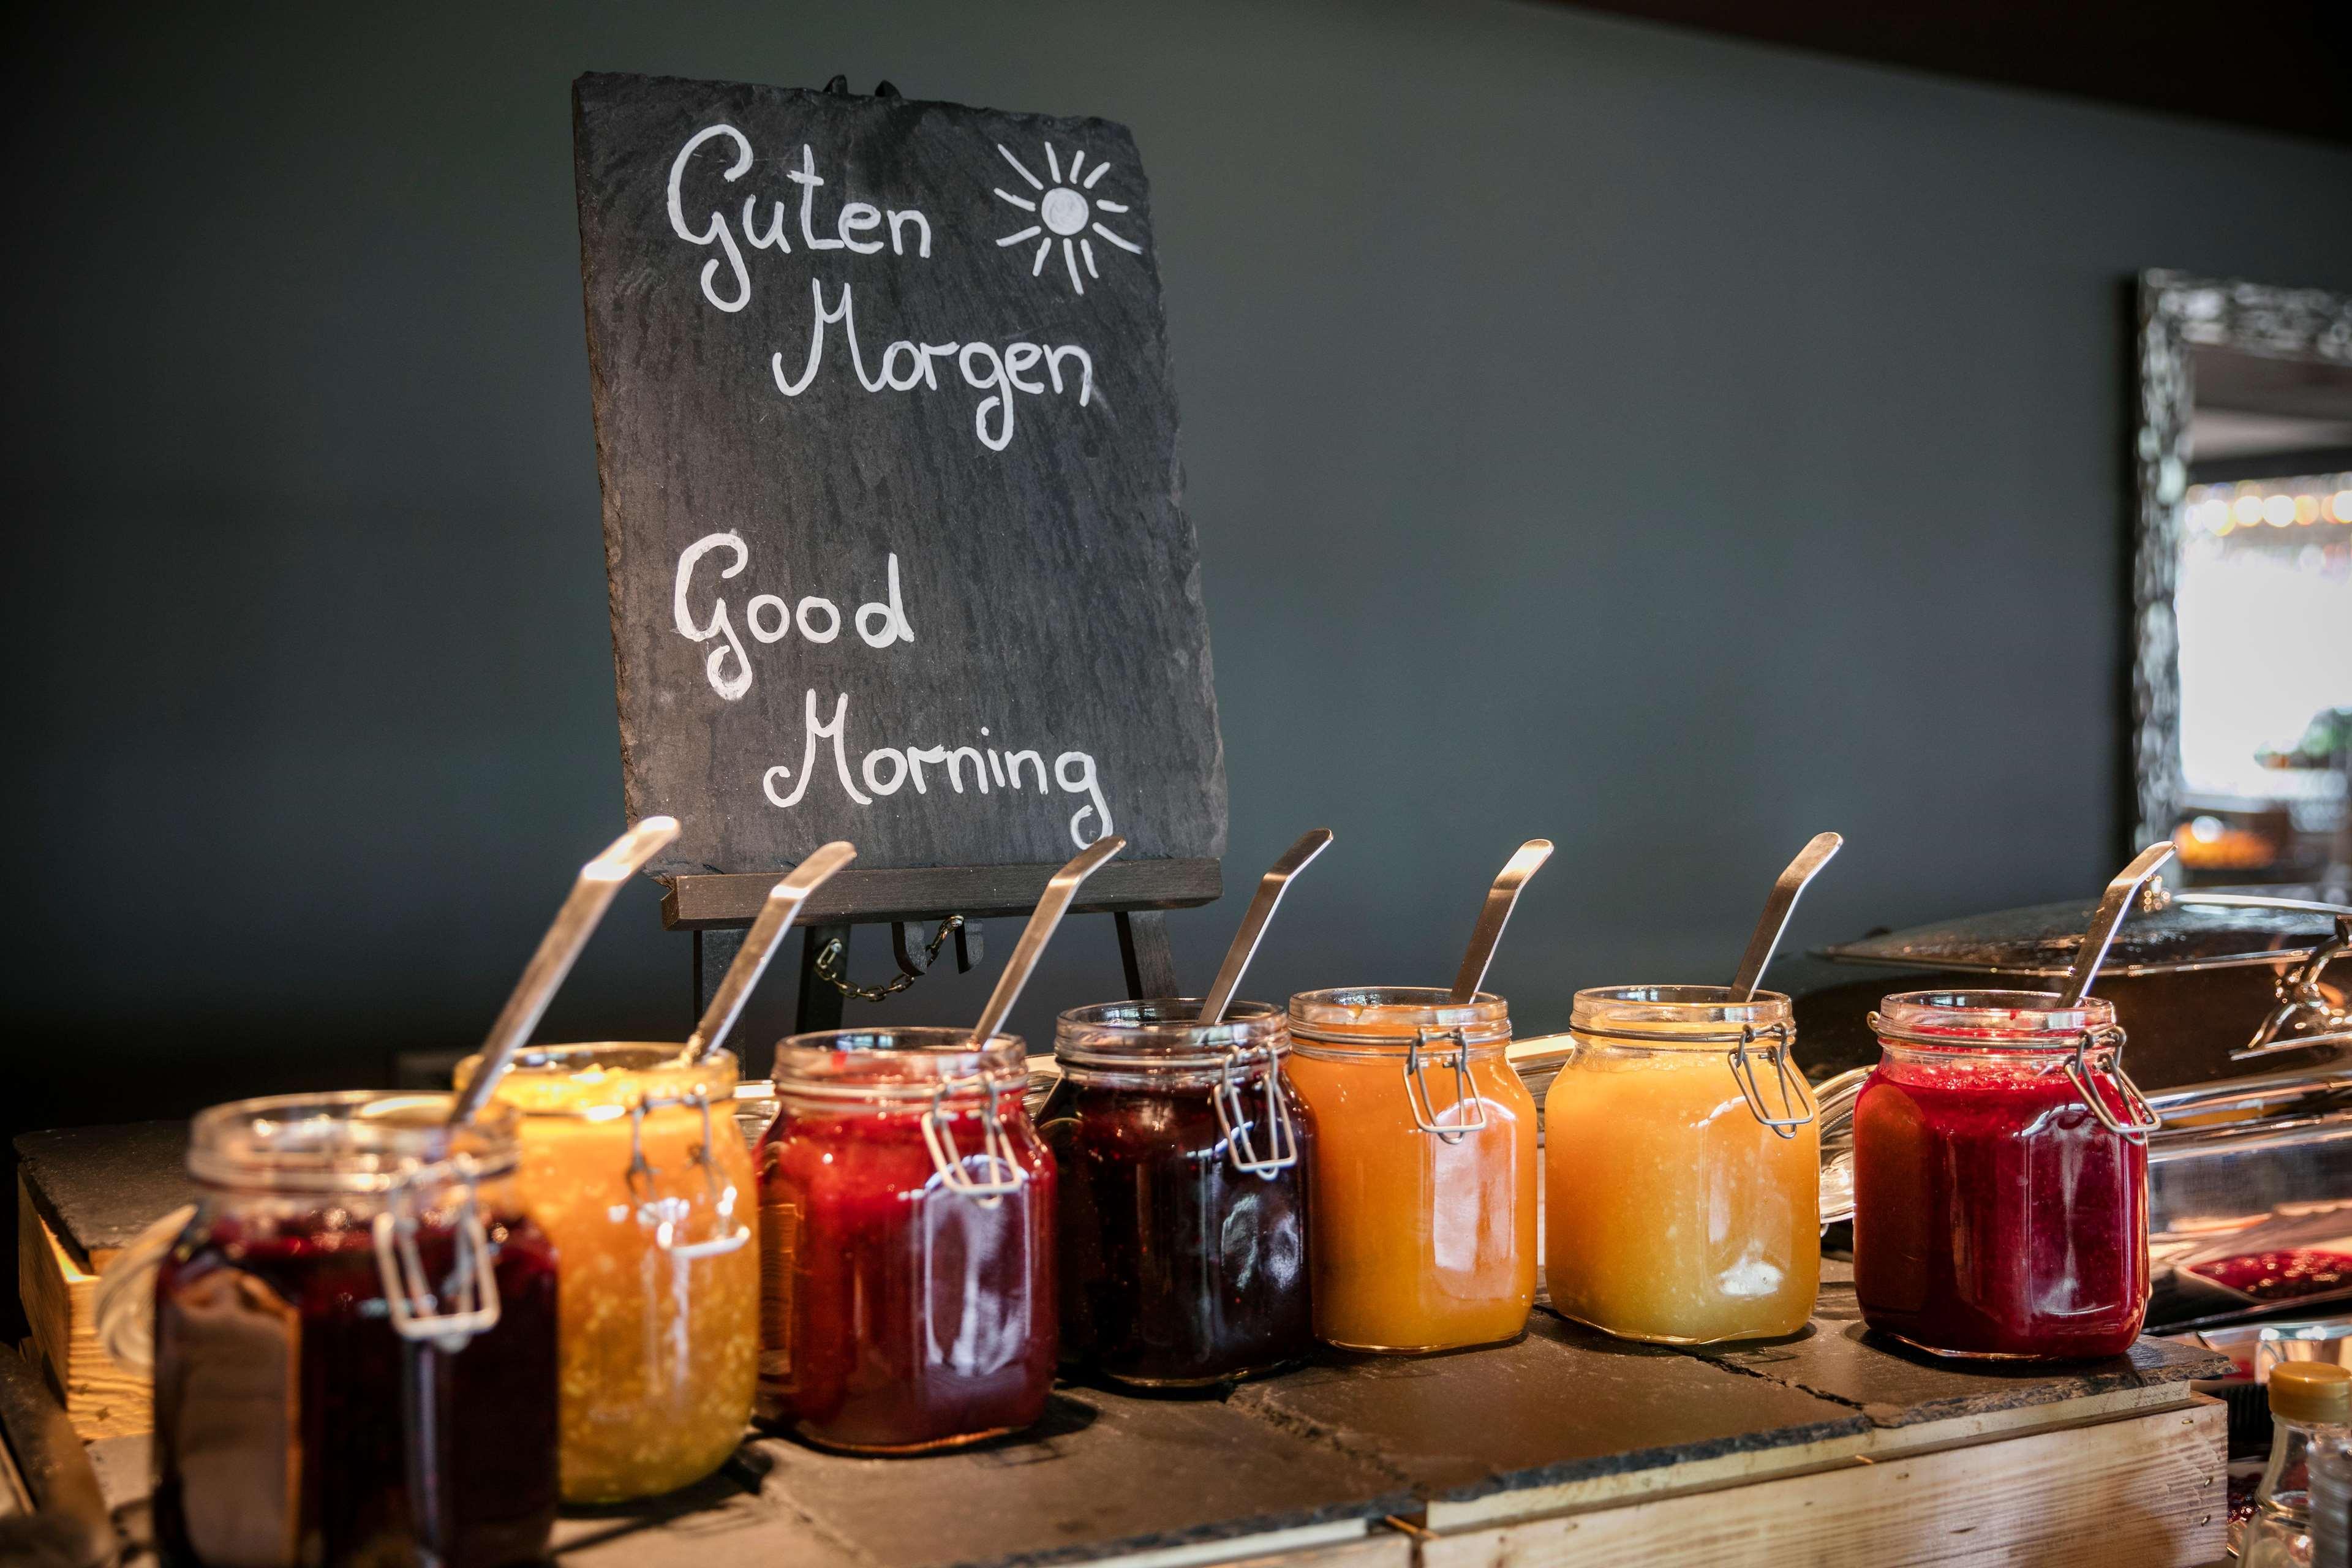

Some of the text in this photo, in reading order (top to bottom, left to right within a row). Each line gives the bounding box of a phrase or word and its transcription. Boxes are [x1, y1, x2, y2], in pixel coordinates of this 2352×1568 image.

[666, 124, 932, 313] Guten
[772, 277, 1093, 451] Morgen
[673, 529, 915, 701] Good
[763, 688, 1114, 850] Morning
